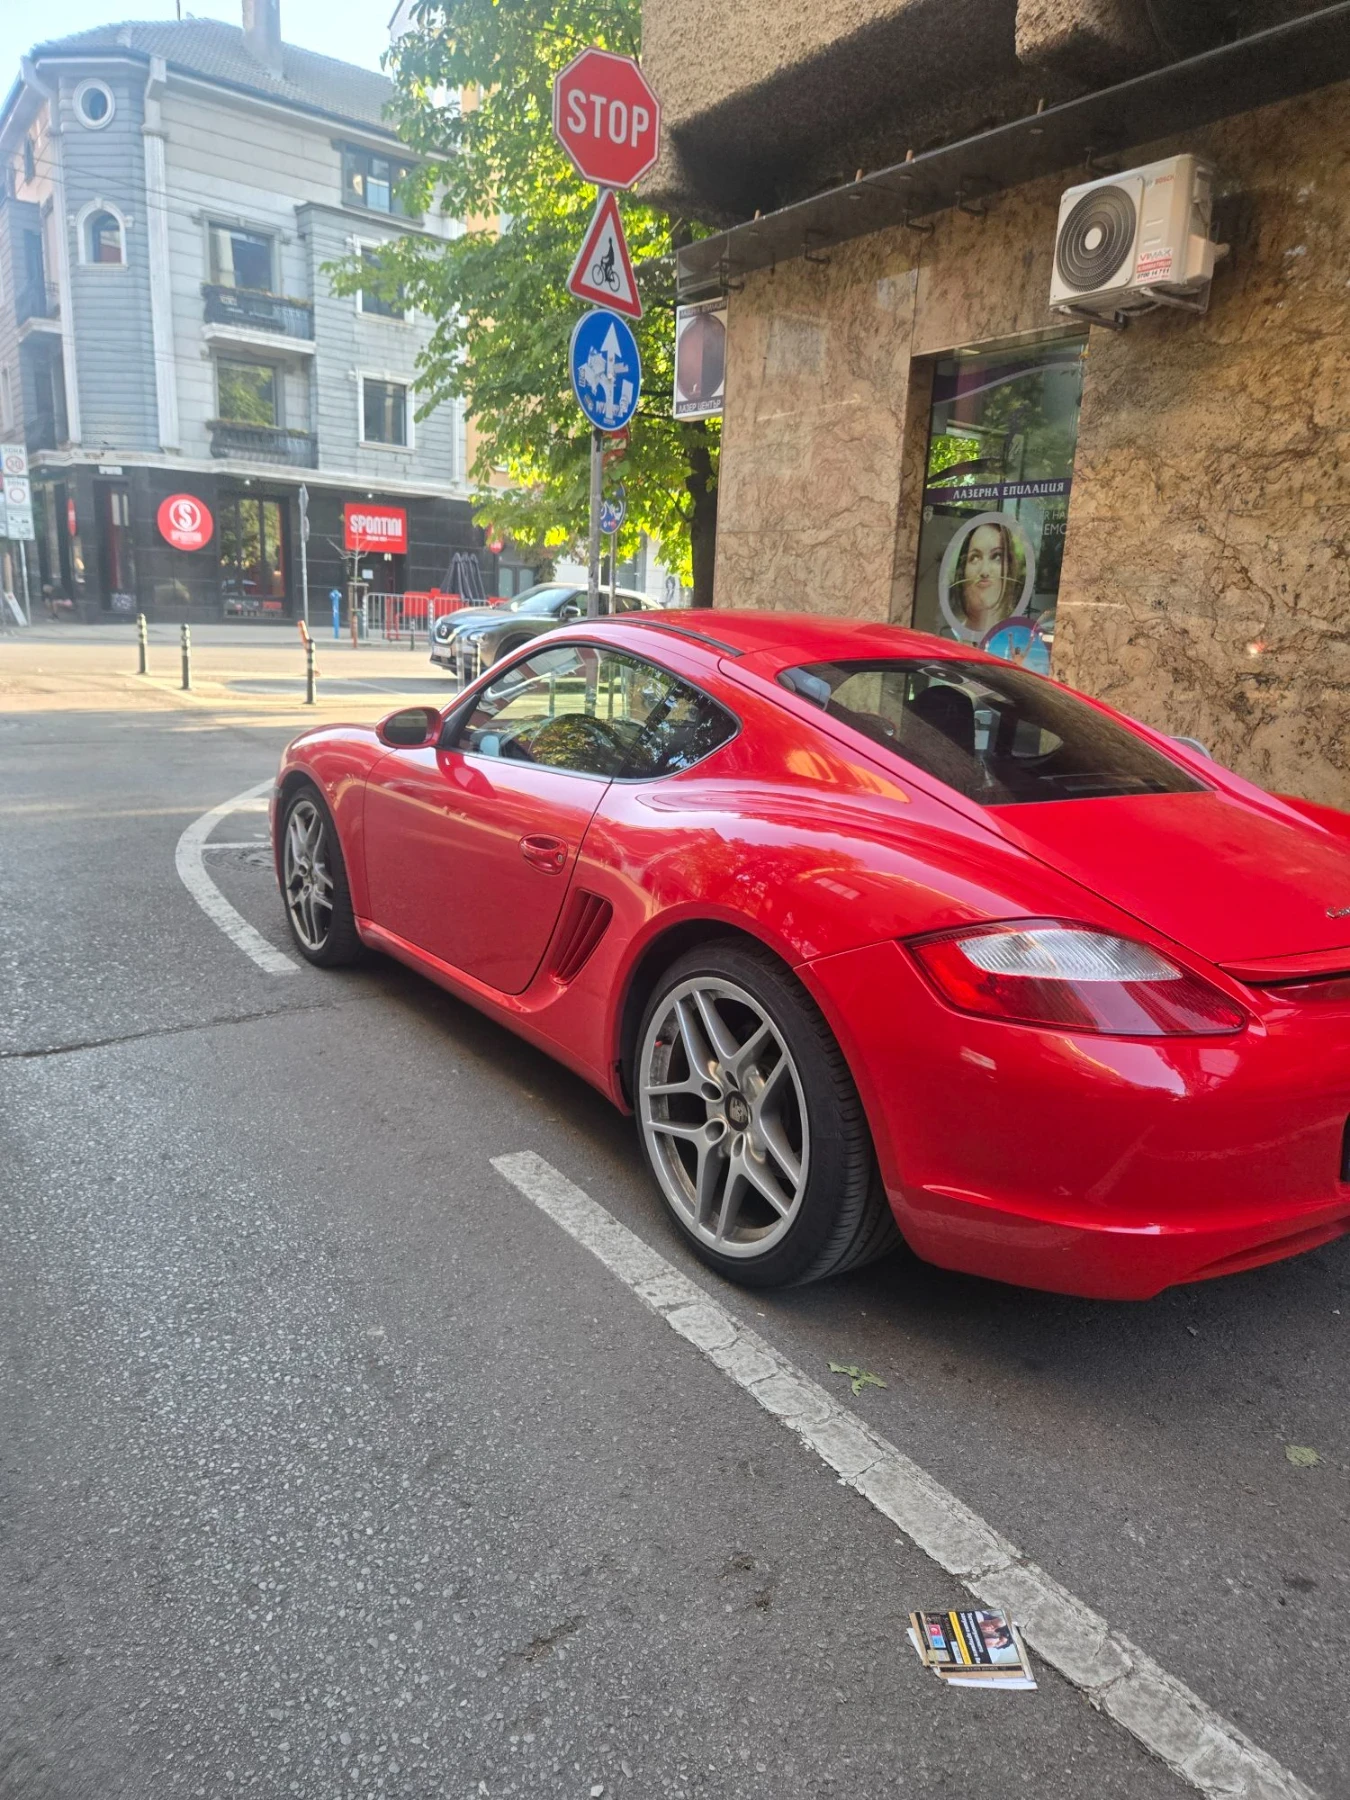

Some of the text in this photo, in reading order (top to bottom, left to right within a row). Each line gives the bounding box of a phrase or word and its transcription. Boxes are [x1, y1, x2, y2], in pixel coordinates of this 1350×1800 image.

[567, 89, 649, 148] STOP
[953, 482, 1064, 499] ЛАЗЕРНА ЕПИЛАЦИЯ
[350, 515, 402, 536] SPONTINI
